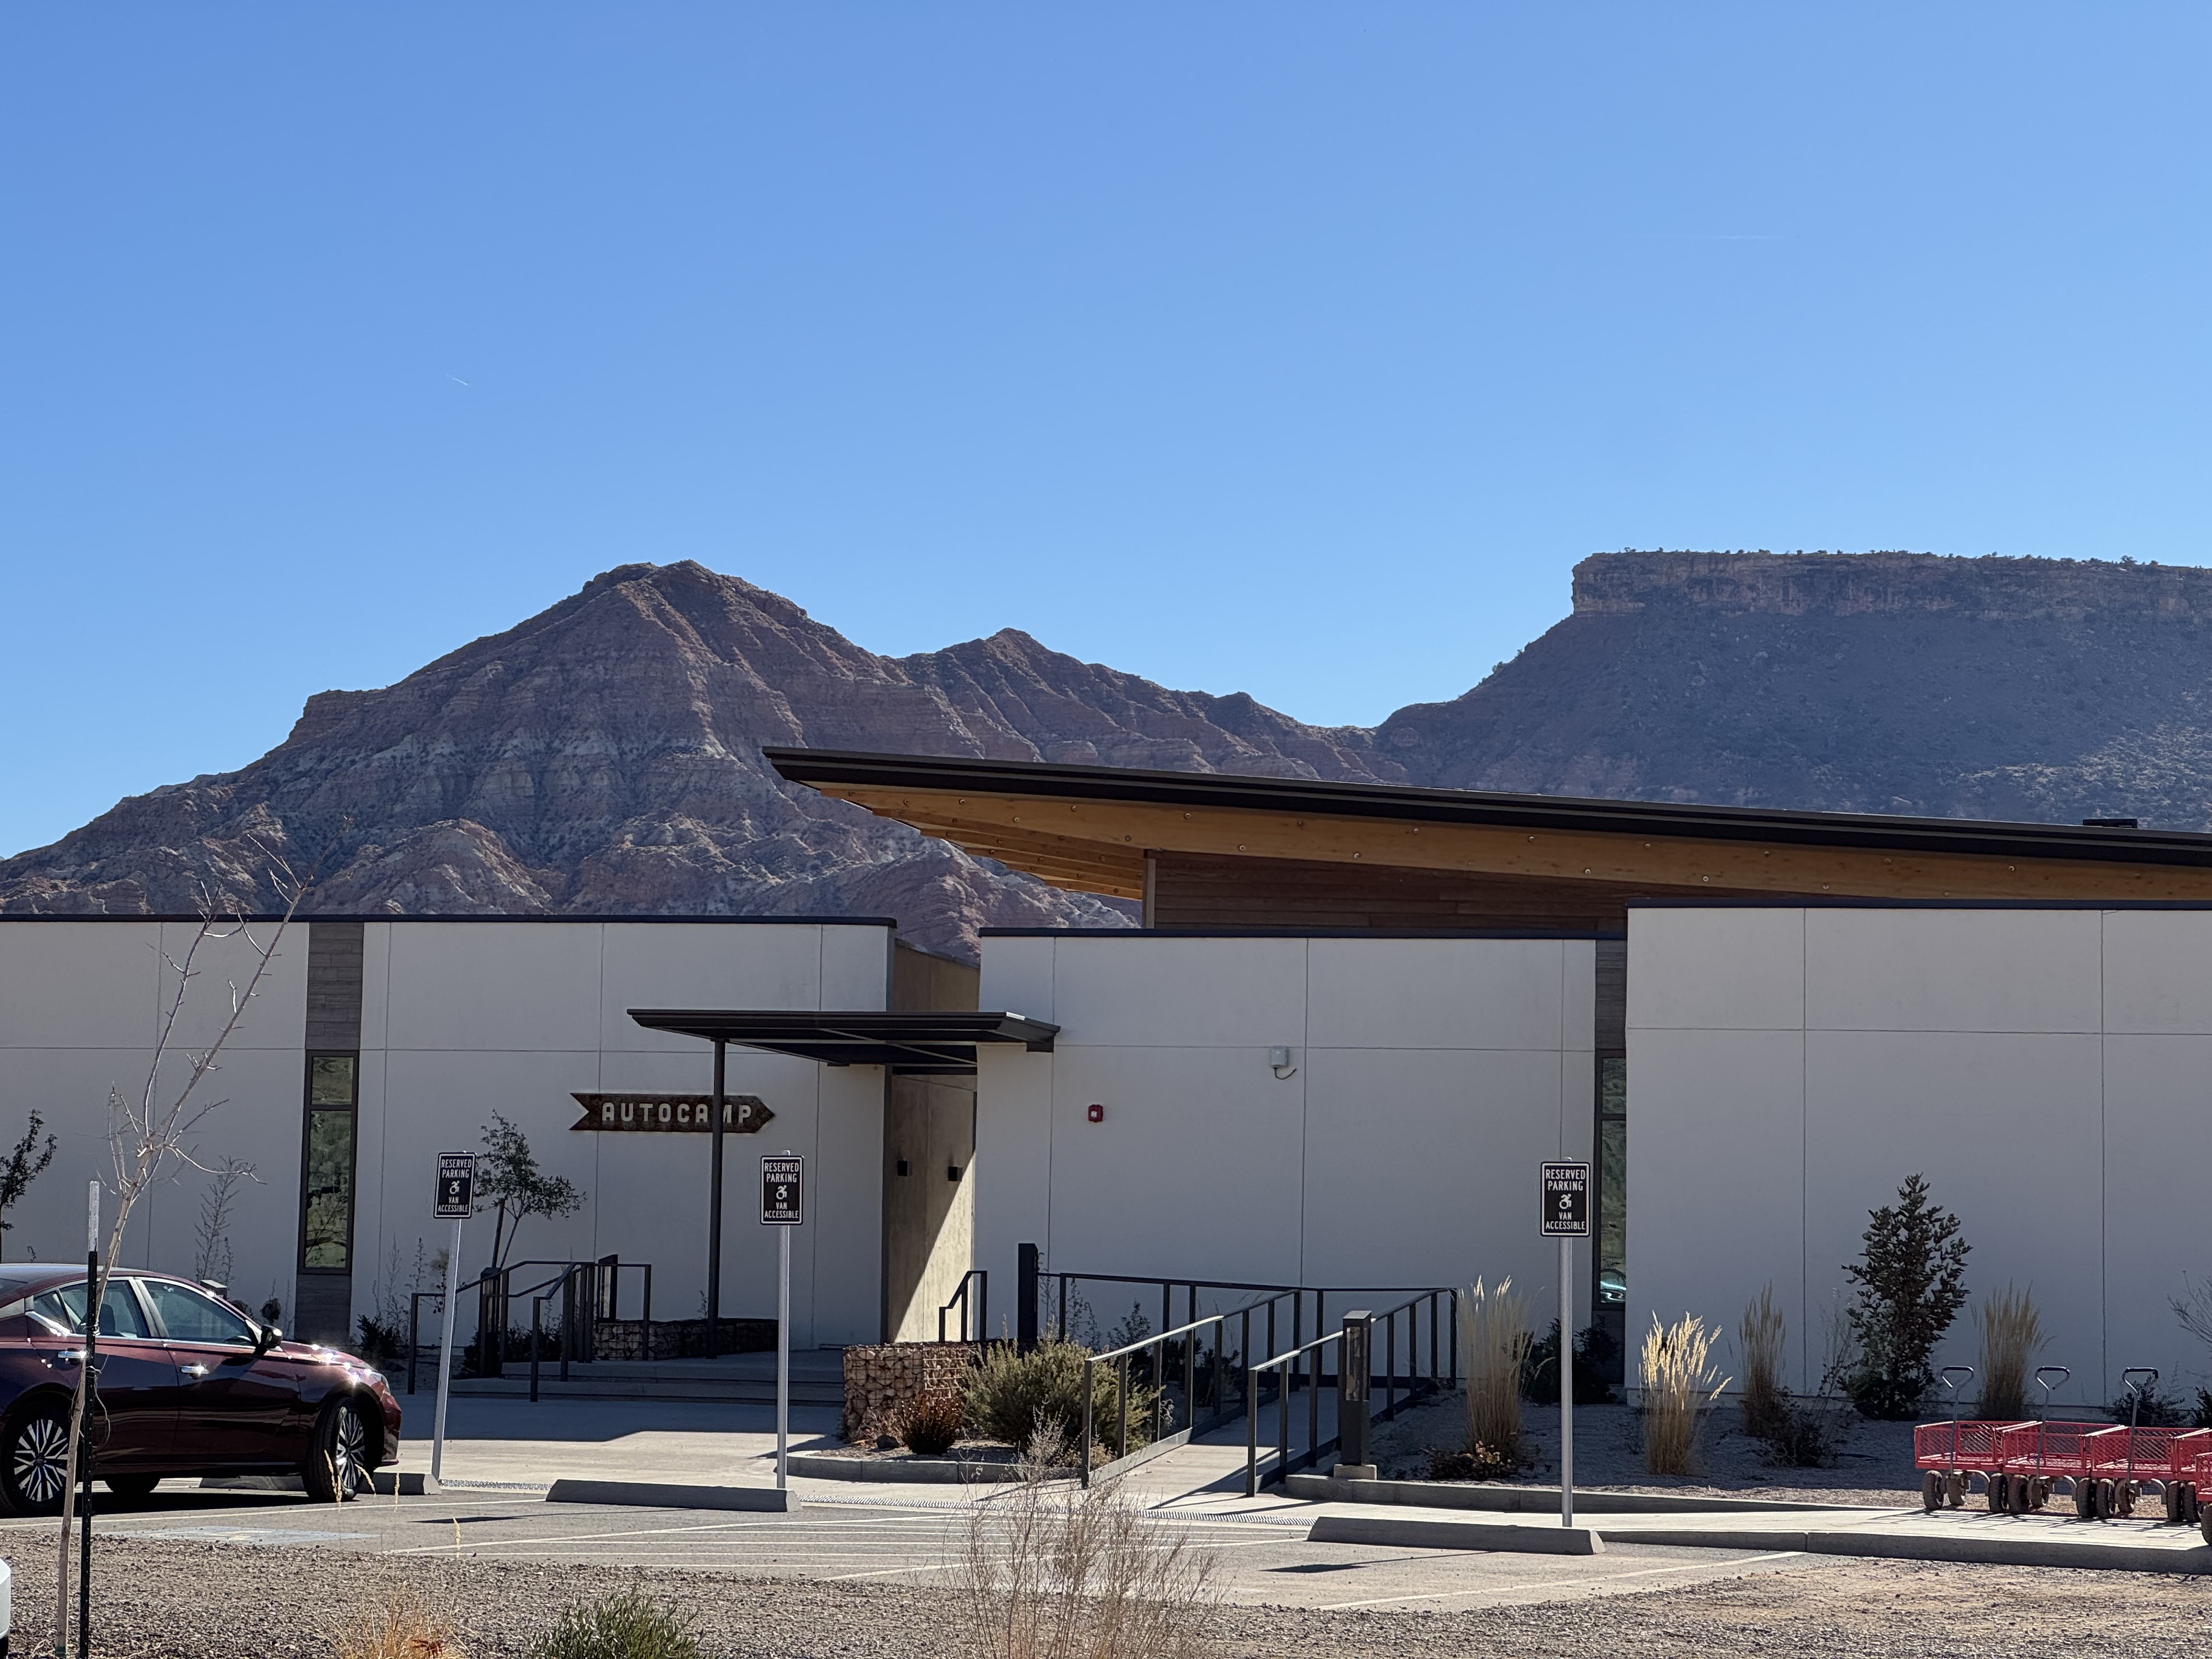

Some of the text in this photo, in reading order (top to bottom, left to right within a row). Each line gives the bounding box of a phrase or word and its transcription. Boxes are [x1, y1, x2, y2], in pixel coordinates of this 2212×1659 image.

[441, 1159, 472, 1168] RESERVED
[764, 1163, 799, 1172] RESERVED
[442, 1169, 470, 1178] PARKING
[766, 1173, 797, 1183] PARKING
[1545, 1169, 1585, 1180] RESERVED
[1548, 1181, 1583, 1191] PARKING
[437, 1204, 469, 1212] ACCESSIBLE
[764, 1210, 799, 1218] ACCESSIBLE
[1559, 1211, 1572, 1220] VAN
[1545, 1221, 1585, 1230] ACCESSIBLE
